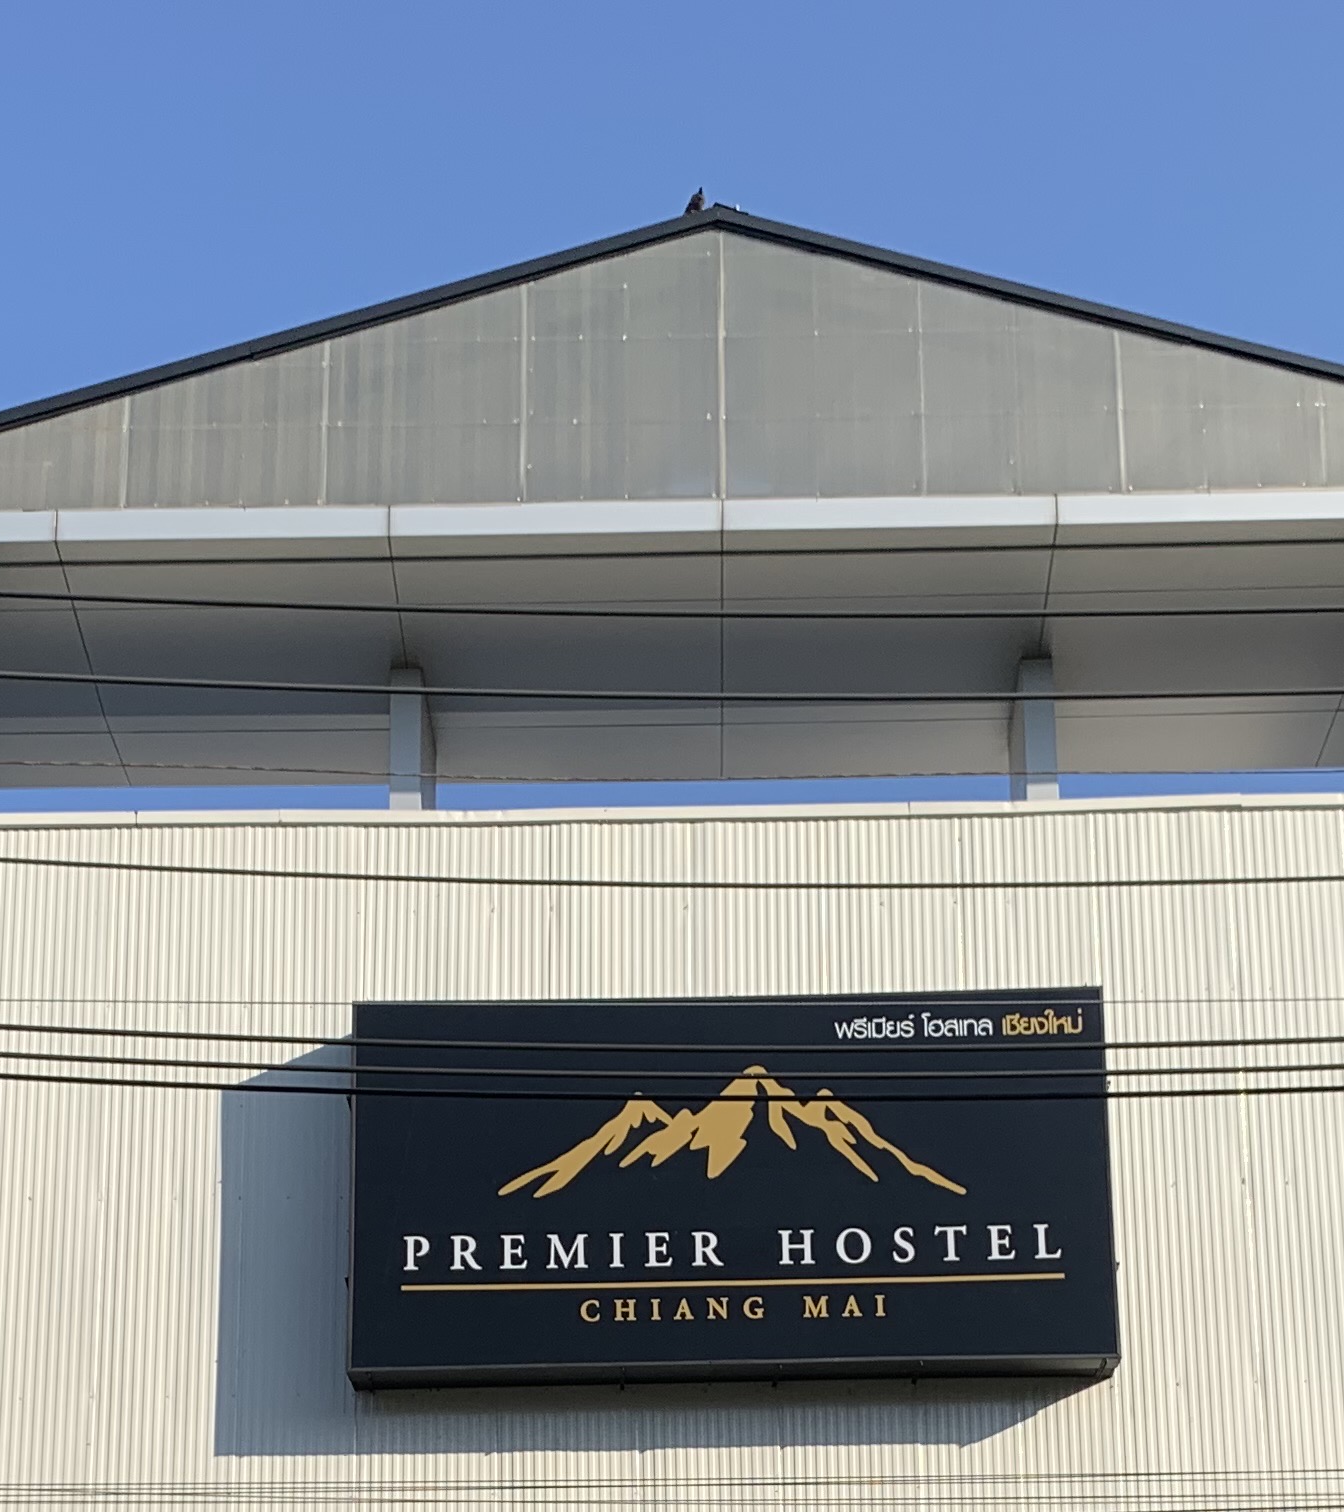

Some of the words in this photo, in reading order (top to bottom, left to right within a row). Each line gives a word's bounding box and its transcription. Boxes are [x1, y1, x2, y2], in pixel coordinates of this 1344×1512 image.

[834, 1013, 916, 1040] พรีเมียร์
[921, 1012, 993, 1038] โฮสเทล
[1002, 1008, 1083, 1036] เชียงใหม่
[403, 1230, 725, 1273] PREMIER
[778, 1223, 1064, 1267] HOSTEL
[580, 1295, 767, 1324] CHIANG
[803, 1293, 889, 1320] MAI
